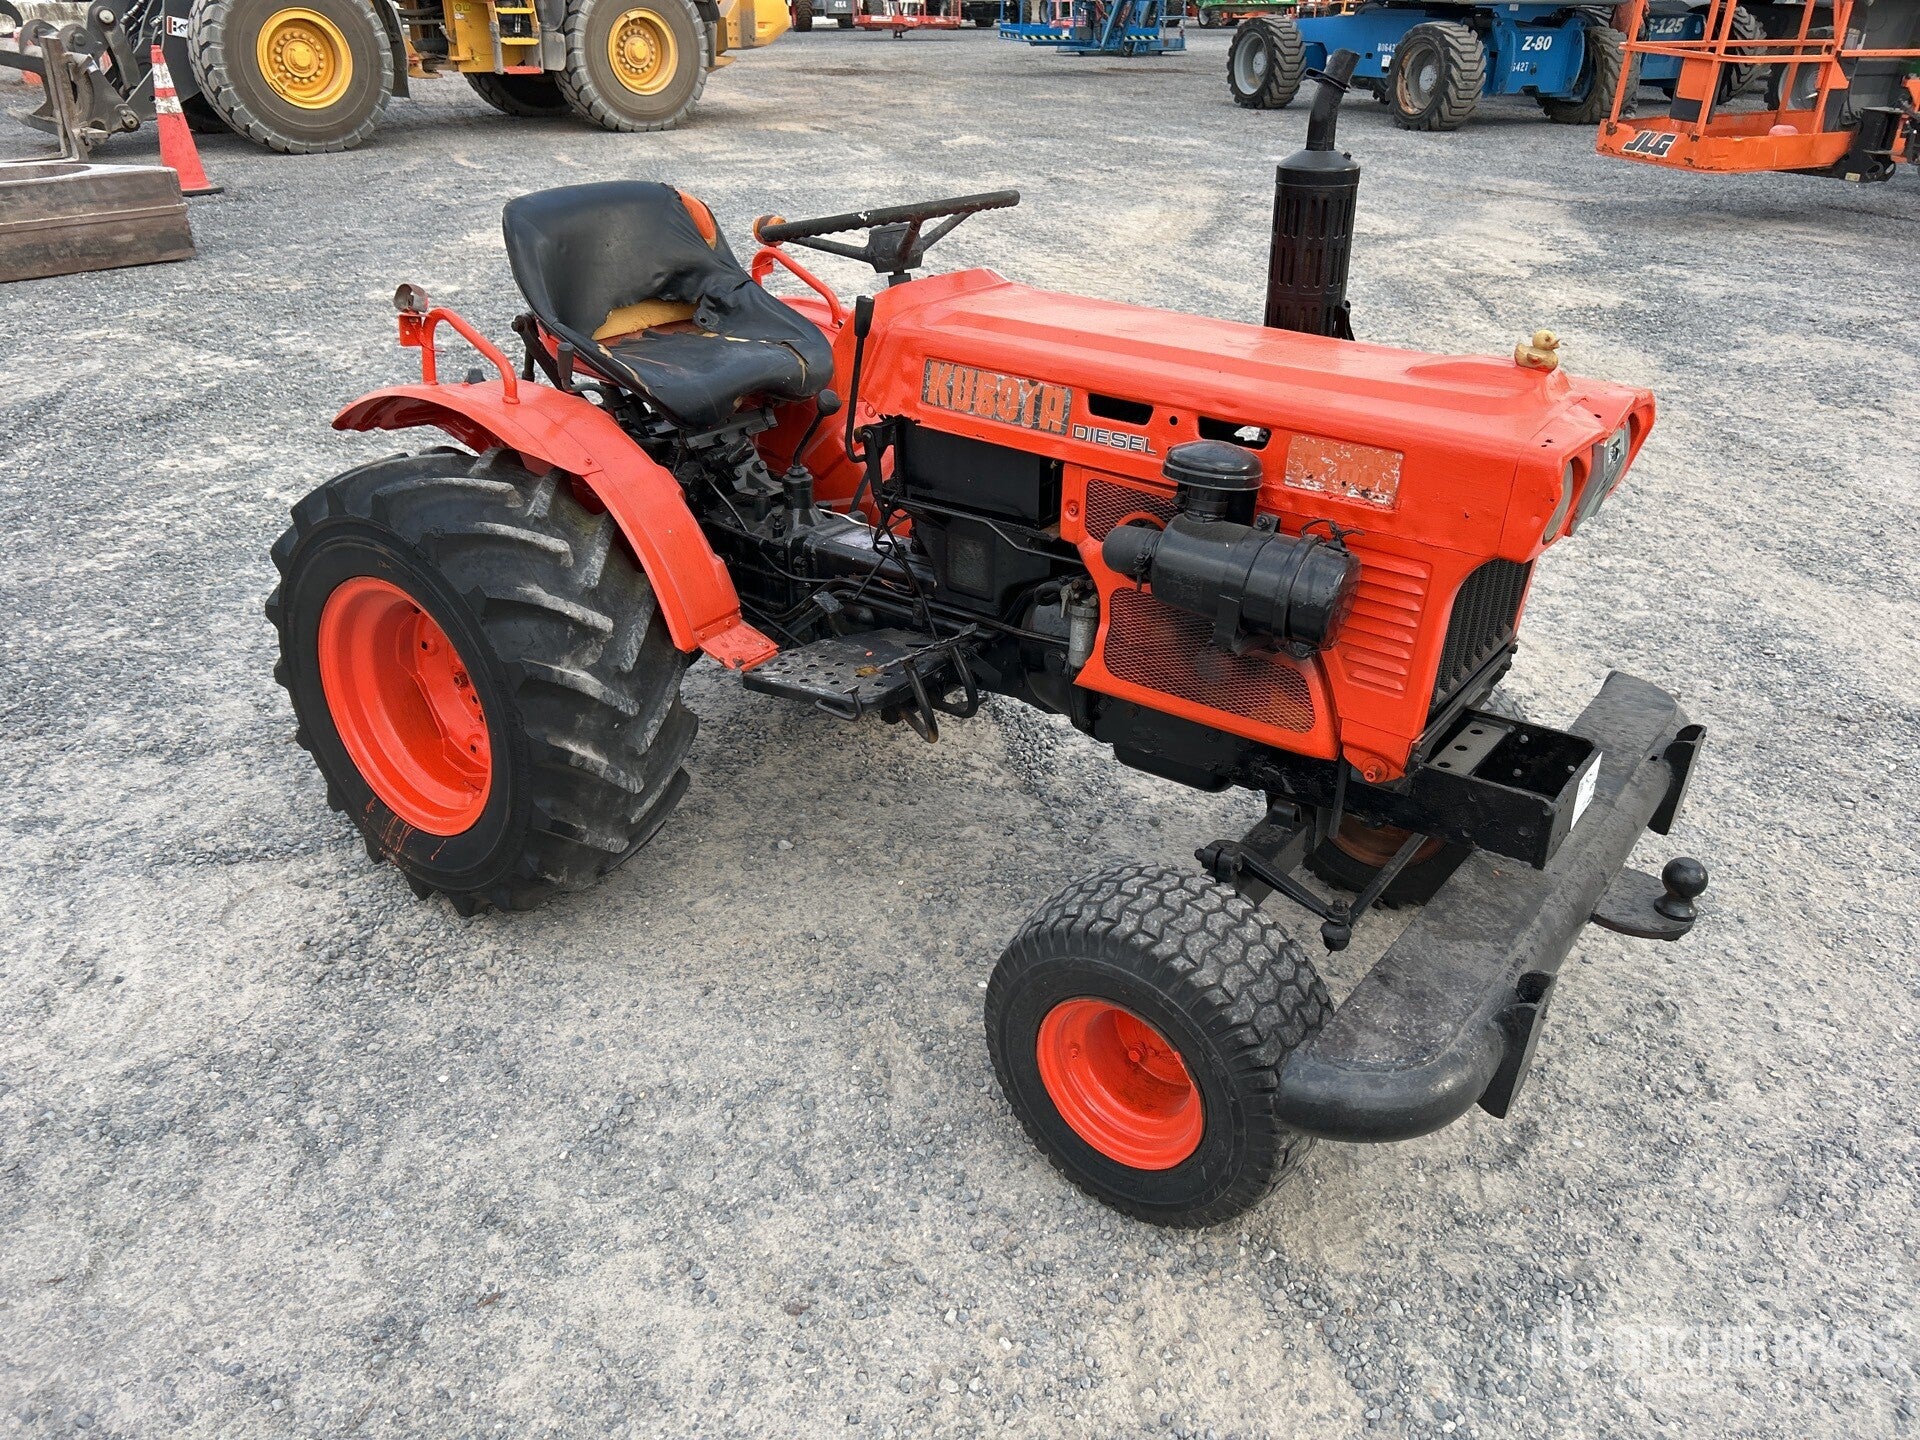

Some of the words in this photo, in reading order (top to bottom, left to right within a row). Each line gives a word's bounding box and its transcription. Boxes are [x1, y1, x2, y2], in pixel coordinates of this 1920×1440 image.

[1521, 35, 1553, 51] Z-80
[1622, 130, 1678, 158] JLG
[925, 359, 1069, 434] KUBOTA
[1072, 423, 1157, 454] DIESEL
